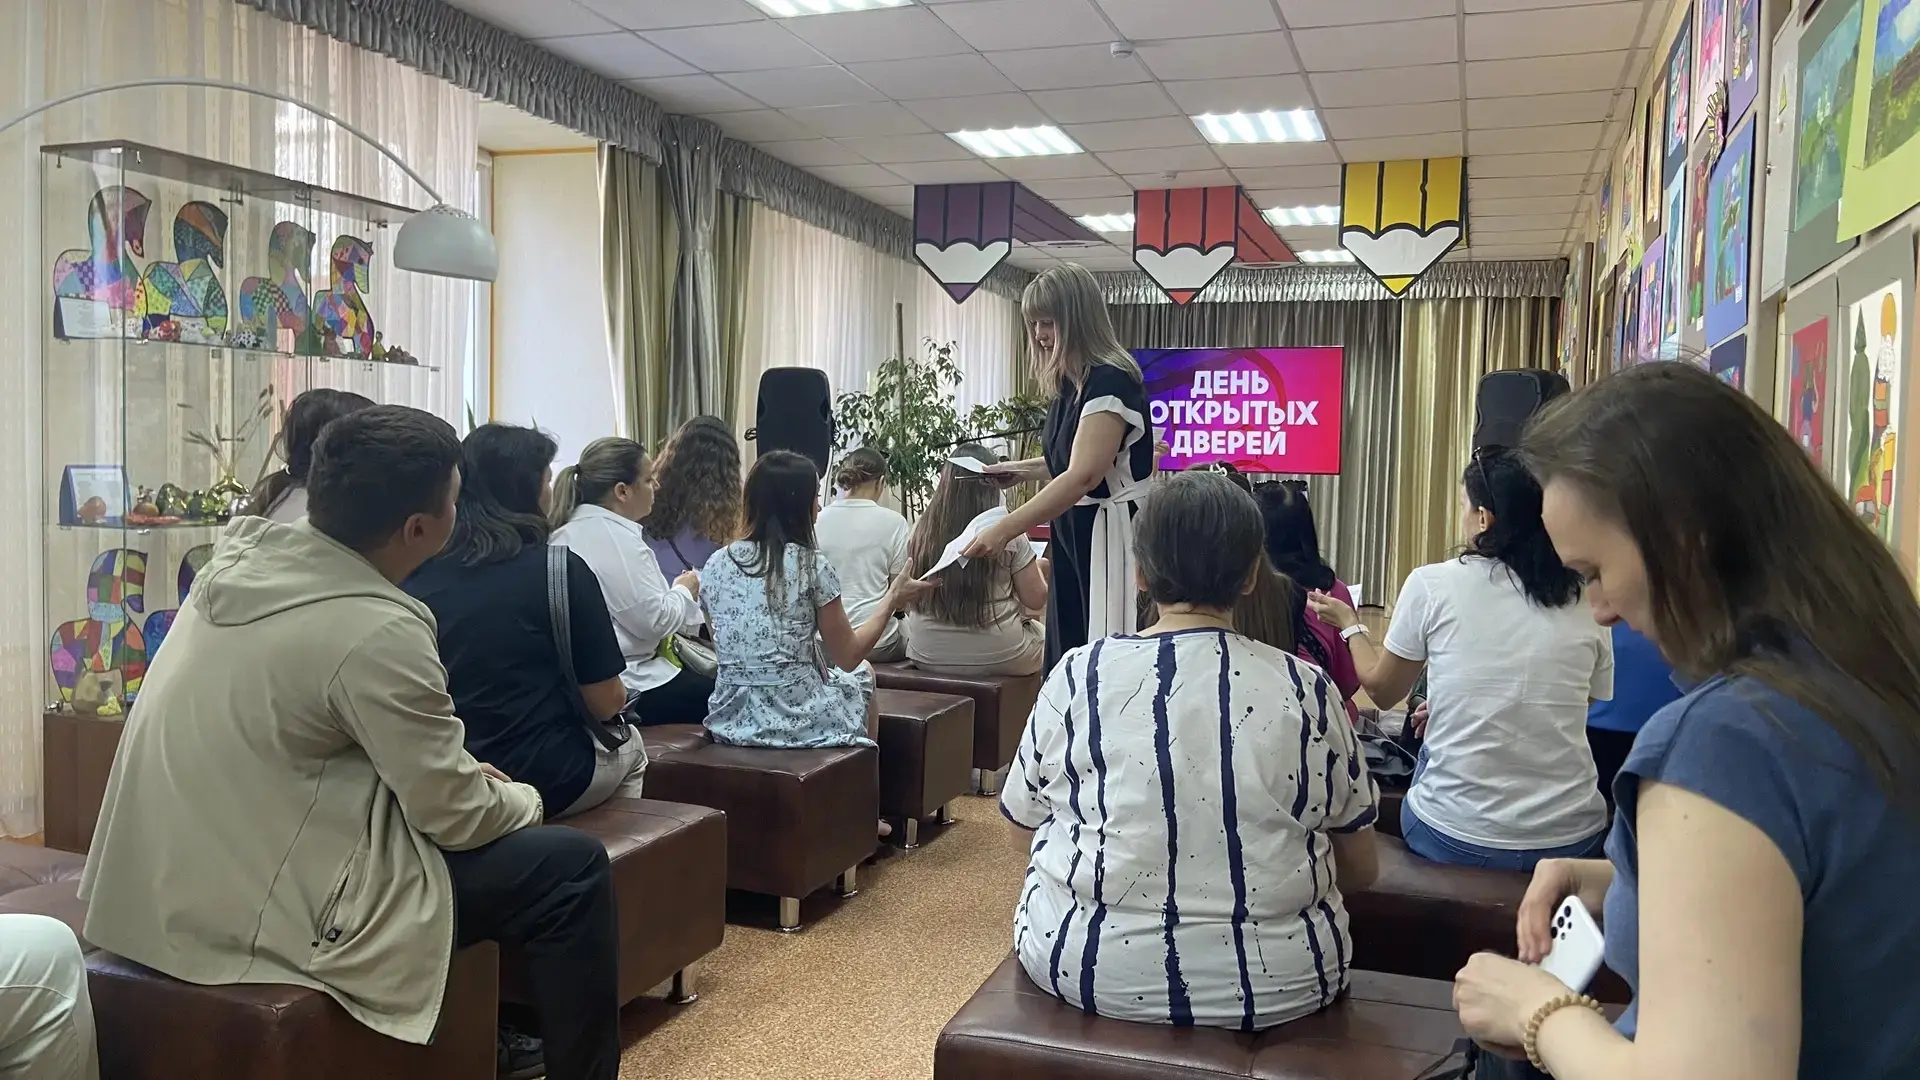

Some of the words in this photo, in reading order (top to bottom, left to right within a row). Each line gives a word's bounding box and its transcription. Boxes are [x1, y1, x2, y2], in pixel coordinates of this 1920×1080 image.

[1190, 370, 1269, 398] ДЕНЬ
[1149, 400, 1319, 425] ОТКРЫТЫХ
[1171, 426, 1287, 457] ДВЕРЕЙ
